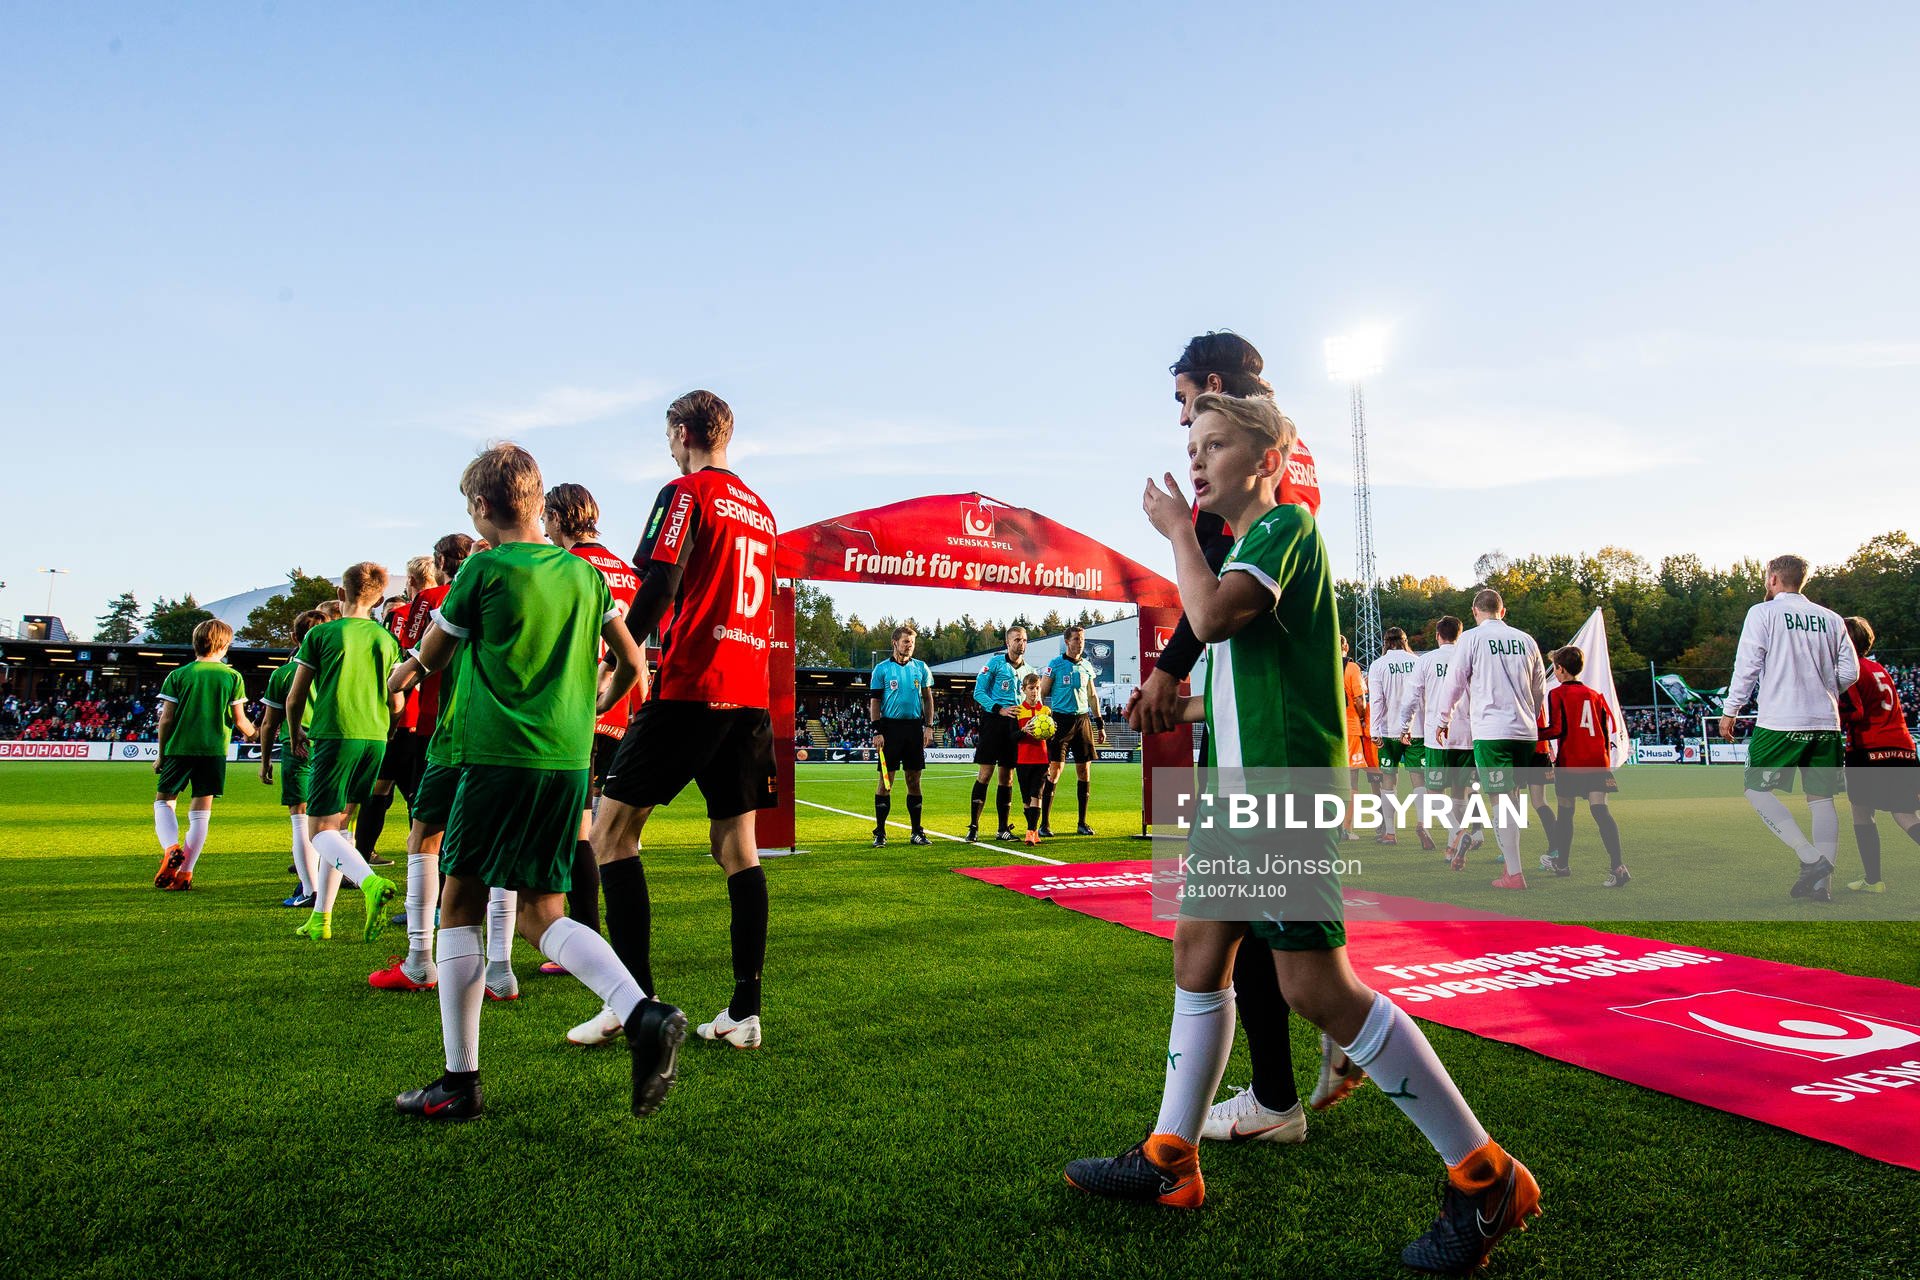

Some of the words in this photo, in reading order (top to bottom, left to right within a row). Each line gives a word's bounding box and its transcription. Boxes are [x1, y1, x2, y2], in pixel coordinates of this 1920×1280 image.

[1287, 460, 1318, 487] SERNE
[664, 493, 692, 548] stadium
[714, 498, 775, 537] SERNEKE
[947, 536, 990, 548] SVENSKA
[992, 541, 1013, 551] SPEL
[735, 536, 768, 619] 15
[844, 547, 926, 577] Framåt
[929, 553, 962, 580] för
[963, 560, 1031, 585] svensk
[1034, 563, 1102, 591] fotboll!
[604, 571, 636, 590] NEKE
[408, 600, 429, 639] stadium
[1784, 612, 1827, 633] BAJEN
[1488, 639, 1526, 656] BAJEN
[1388, 661, 1416, 675] BAJEN
[1872, 671, 1894, 711] 5
[1579, 700, 1596, 737] 4
[0, 744, 87, 757] BAUHAUS
[930, 752, 970, 760] Volkswagen
[1100, 751, 1129, 759] SERNEKE
[1646, 749, 1673, 757] Husab
[1870, 751, 1916, 760] BAUHAUS
[1389, 970, 1570, 1002] svensk
